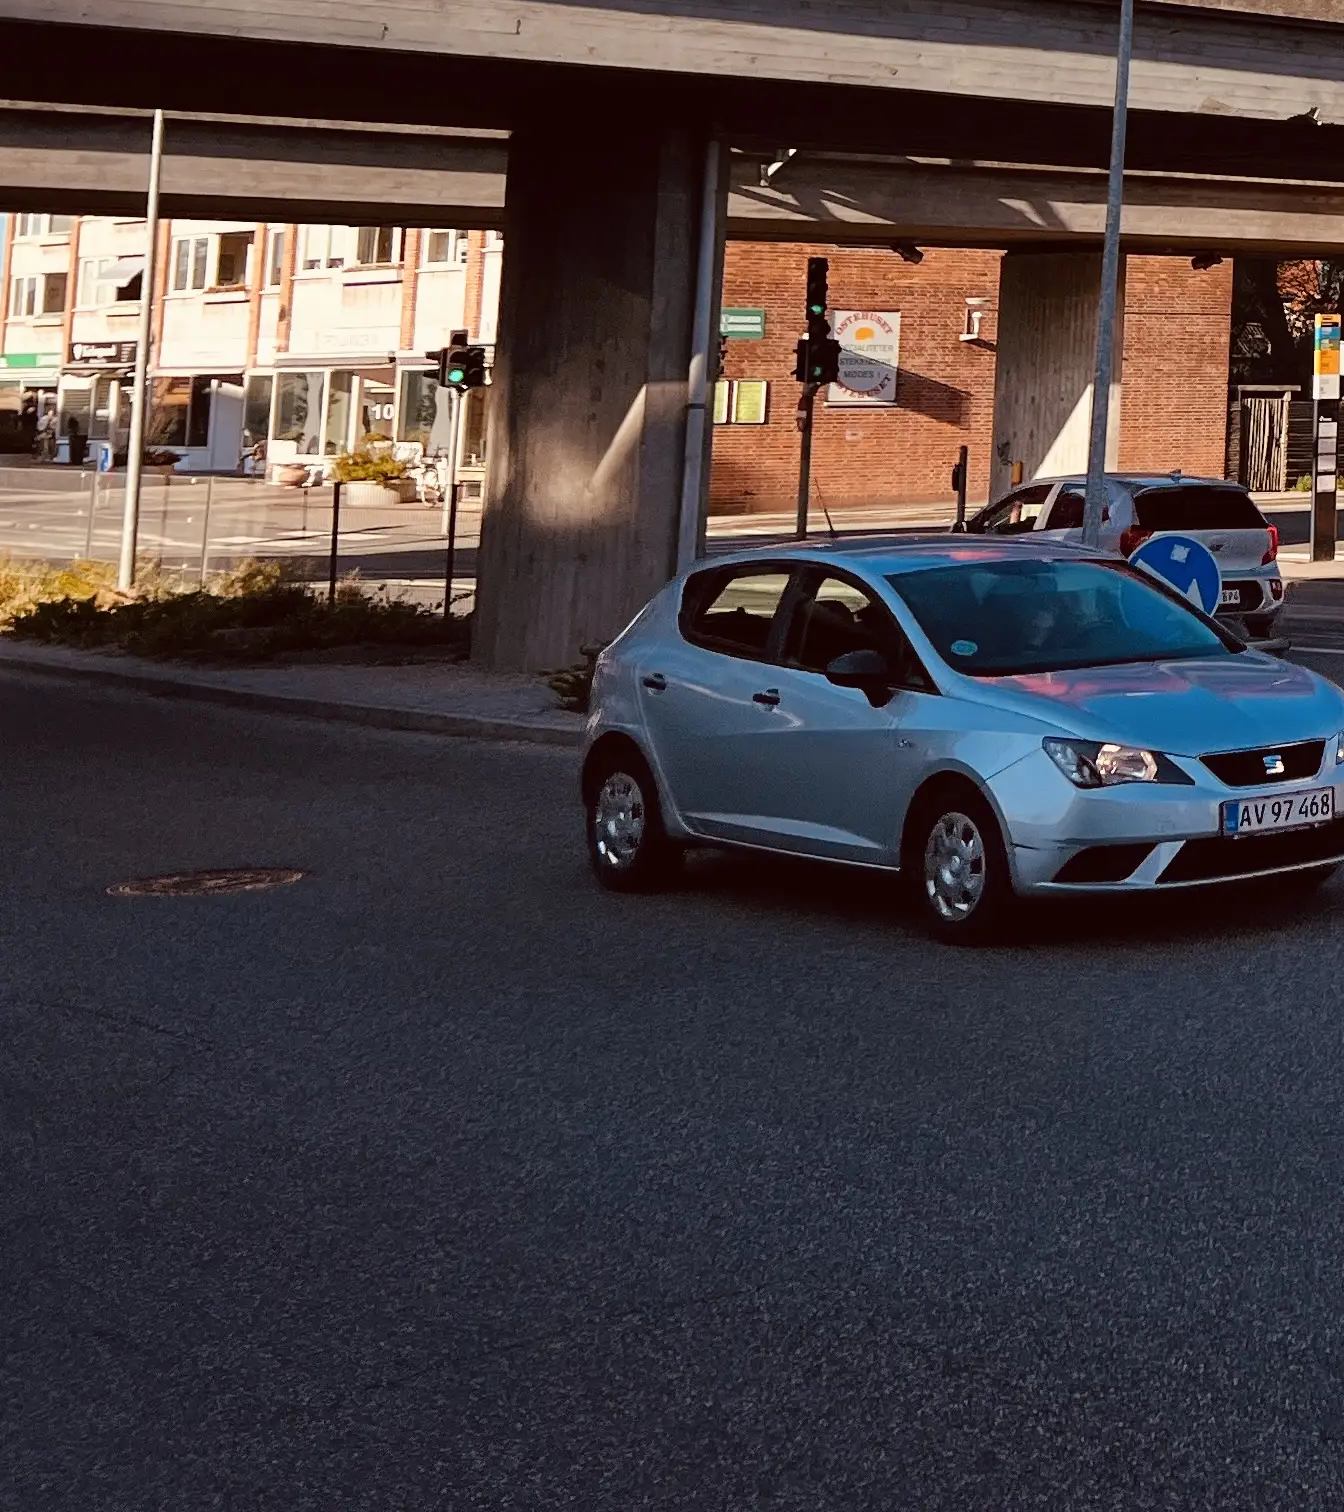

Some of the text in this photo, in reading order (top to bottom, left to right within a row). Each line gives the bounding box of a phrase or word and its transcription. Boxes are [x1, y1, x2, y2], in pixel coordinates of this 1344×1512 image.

[835, 311, 894, 336] OSTEHUSET
[370, 403, 395, 421] 10
[1240, 792, 1331, 827] AV 97 468
